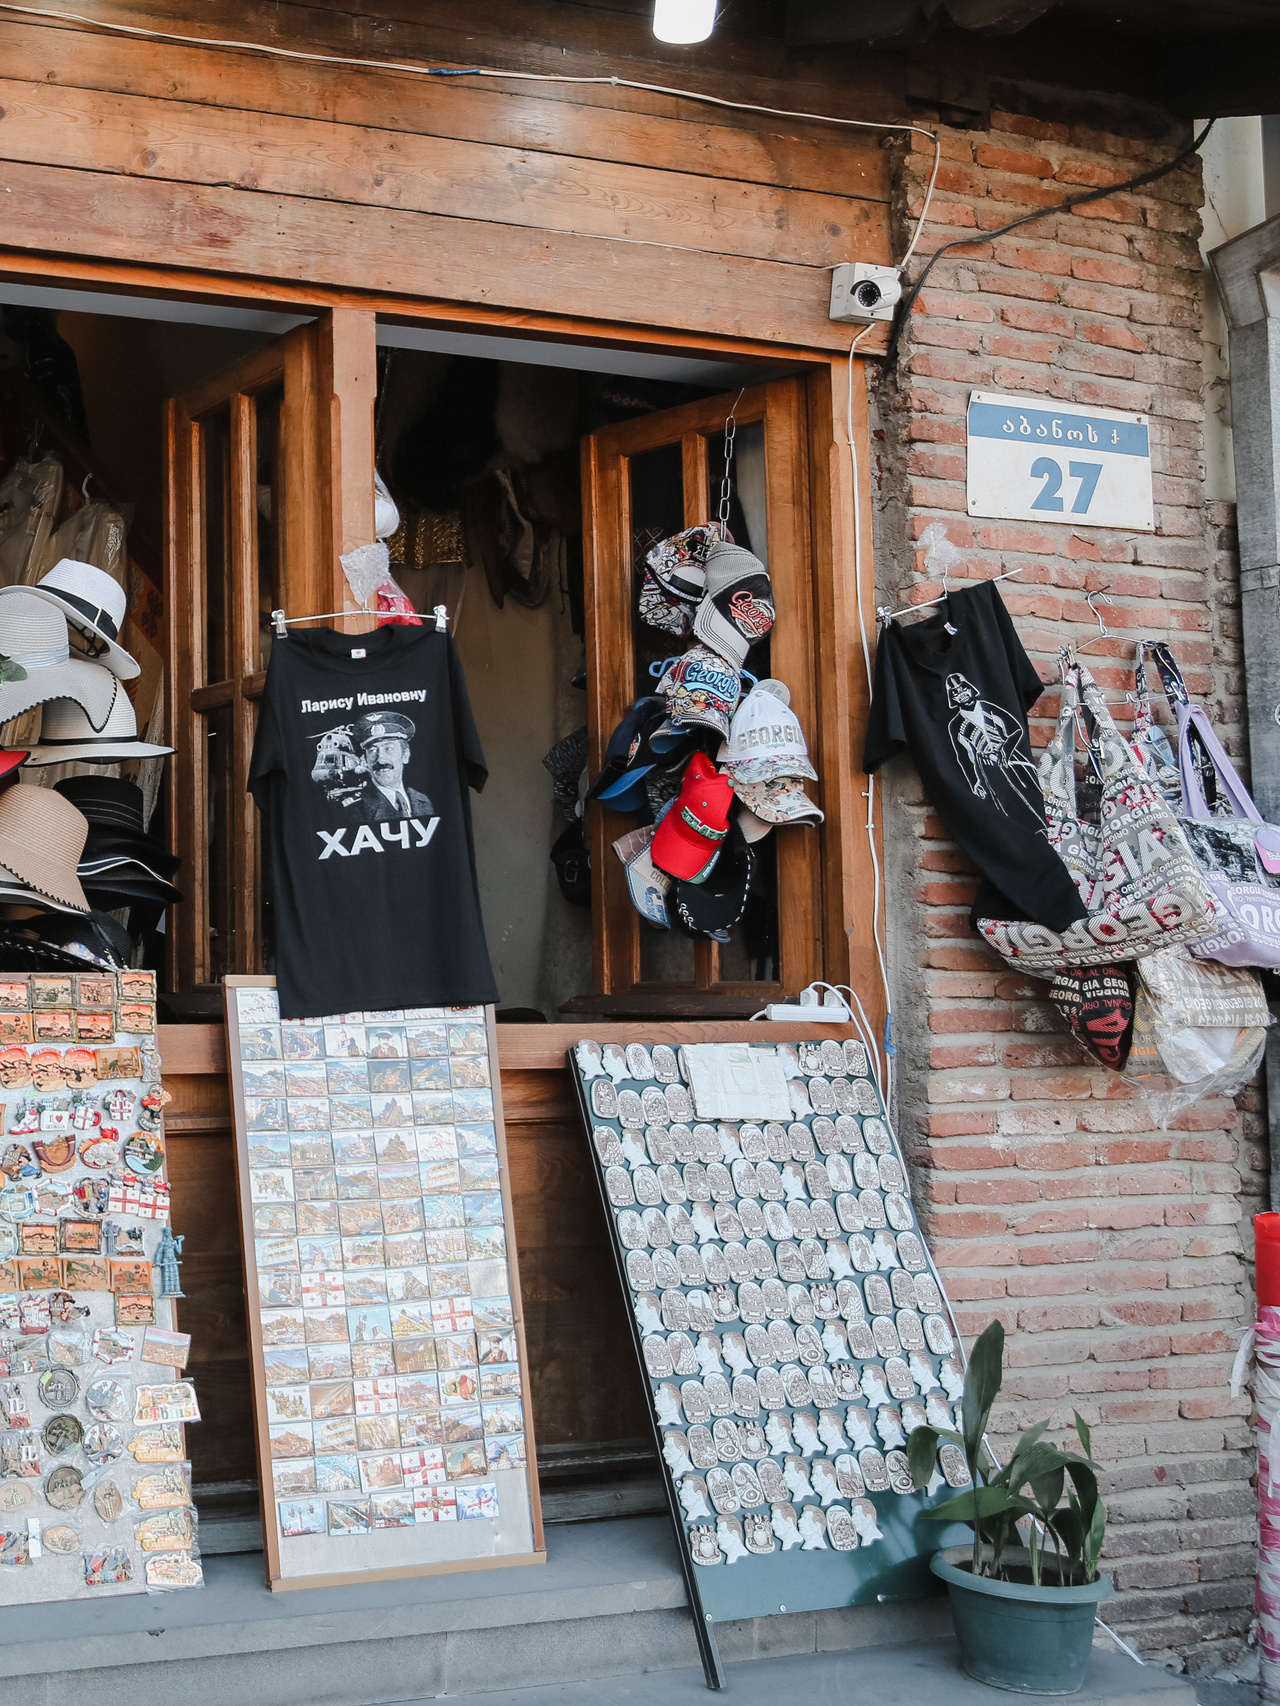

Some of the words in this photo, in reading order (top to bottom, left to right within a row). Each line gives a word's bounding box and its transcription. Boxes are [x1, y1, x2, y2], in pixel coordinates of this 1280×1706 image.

[1003, 415, 1098, 443] აბანოს
[1029, 456, 1103, 515] 27
[301, 697, 353, 713] Ларису
[357, 689, 427, 706] Ивановну
[1129, 811, 1169, 831] ORIGINAL
[316, 817, 441, 860] ХАЧУ
[1063, 946, 1100, 959] ORIGINAL
[1104, 935, 1147, 953] ORIGINAL
[149, 1402, 197, 1421] Tbilisi
